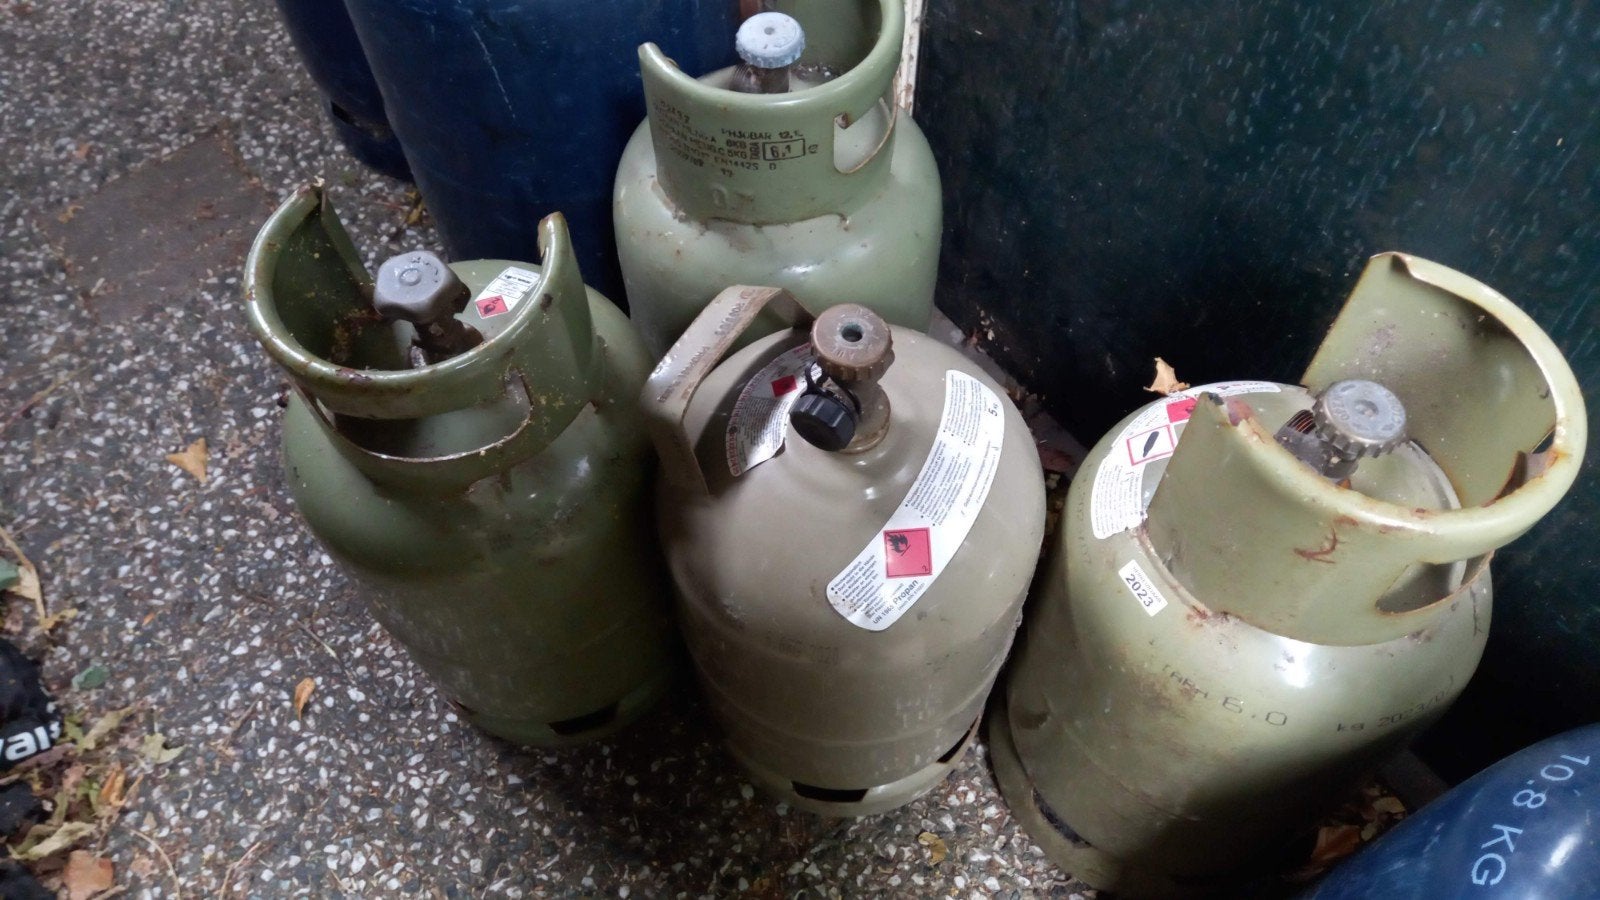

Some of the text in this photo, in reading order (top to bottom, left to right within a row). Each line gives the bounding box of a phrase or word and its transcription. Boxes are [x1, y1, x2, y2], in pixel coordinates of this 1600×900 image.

[892, 579, 919, 605] Propan
[1125, 573, 1154, 607] 2023
[1471, 754, 1591, 886] 10.8 KG
